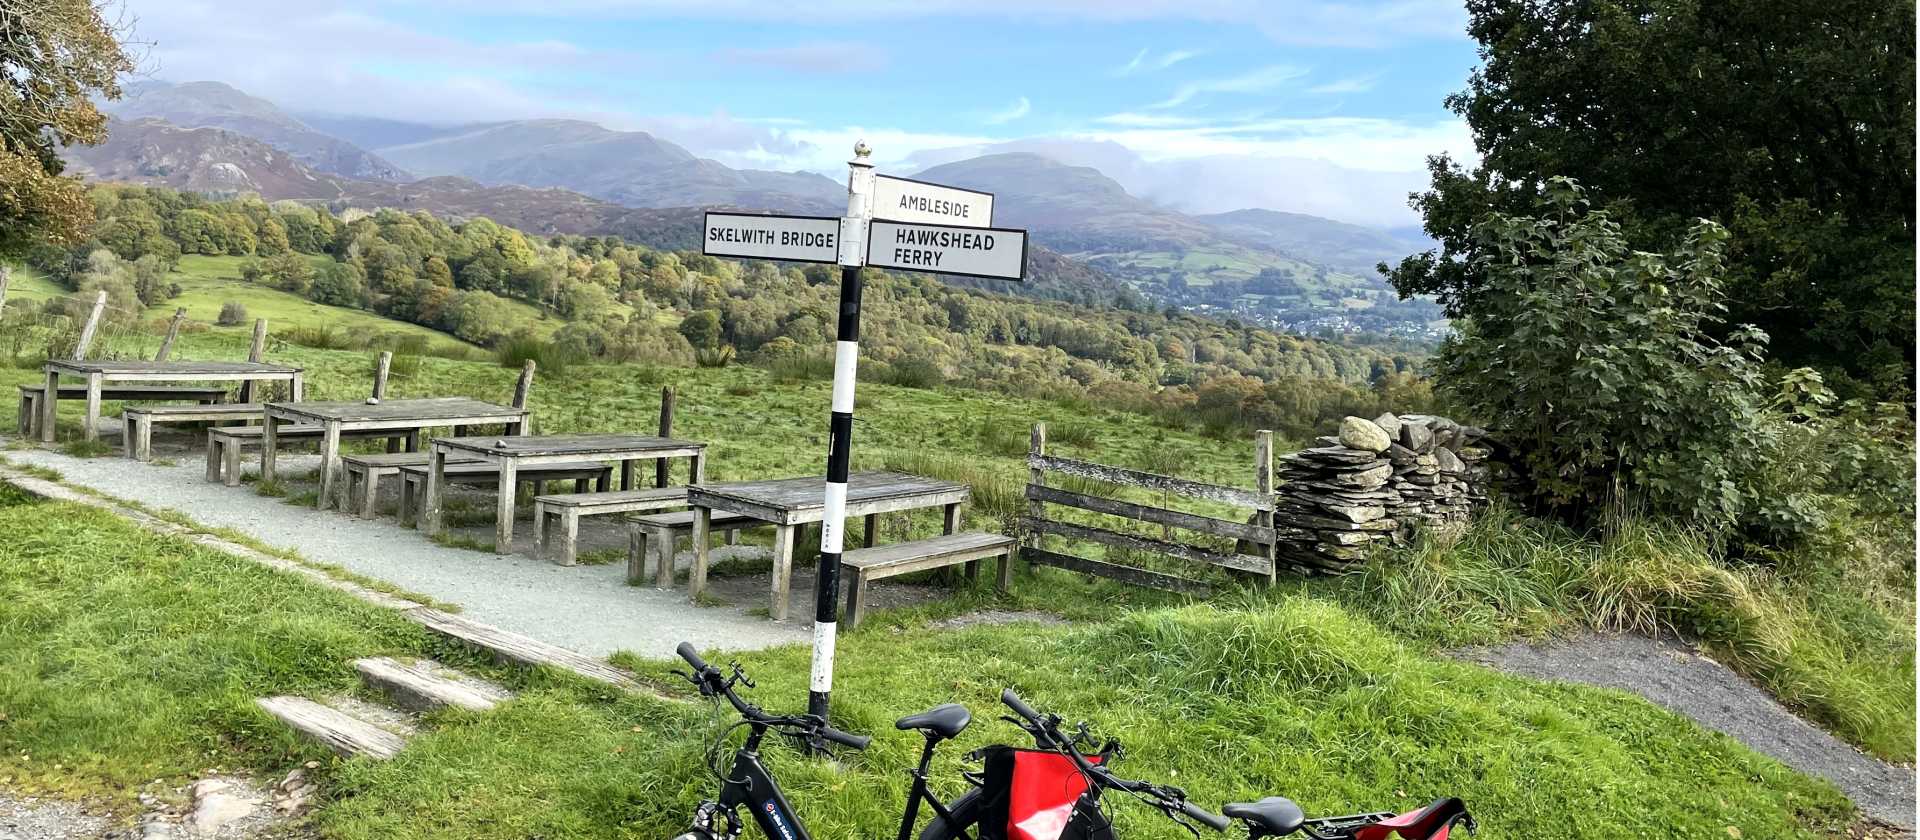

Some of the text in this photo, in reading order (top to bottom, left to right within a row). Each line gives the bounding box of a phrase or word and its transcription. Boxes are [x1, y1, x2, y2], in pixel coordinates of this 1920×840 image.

[899, 194, 969, 218] AMBLESIDE
[709, 227, 834, 248] SKELWITH BRIDGE
[896, 228, 995, 251] HAWKSHEAD
[894, 248, 943, 267] FERRY
